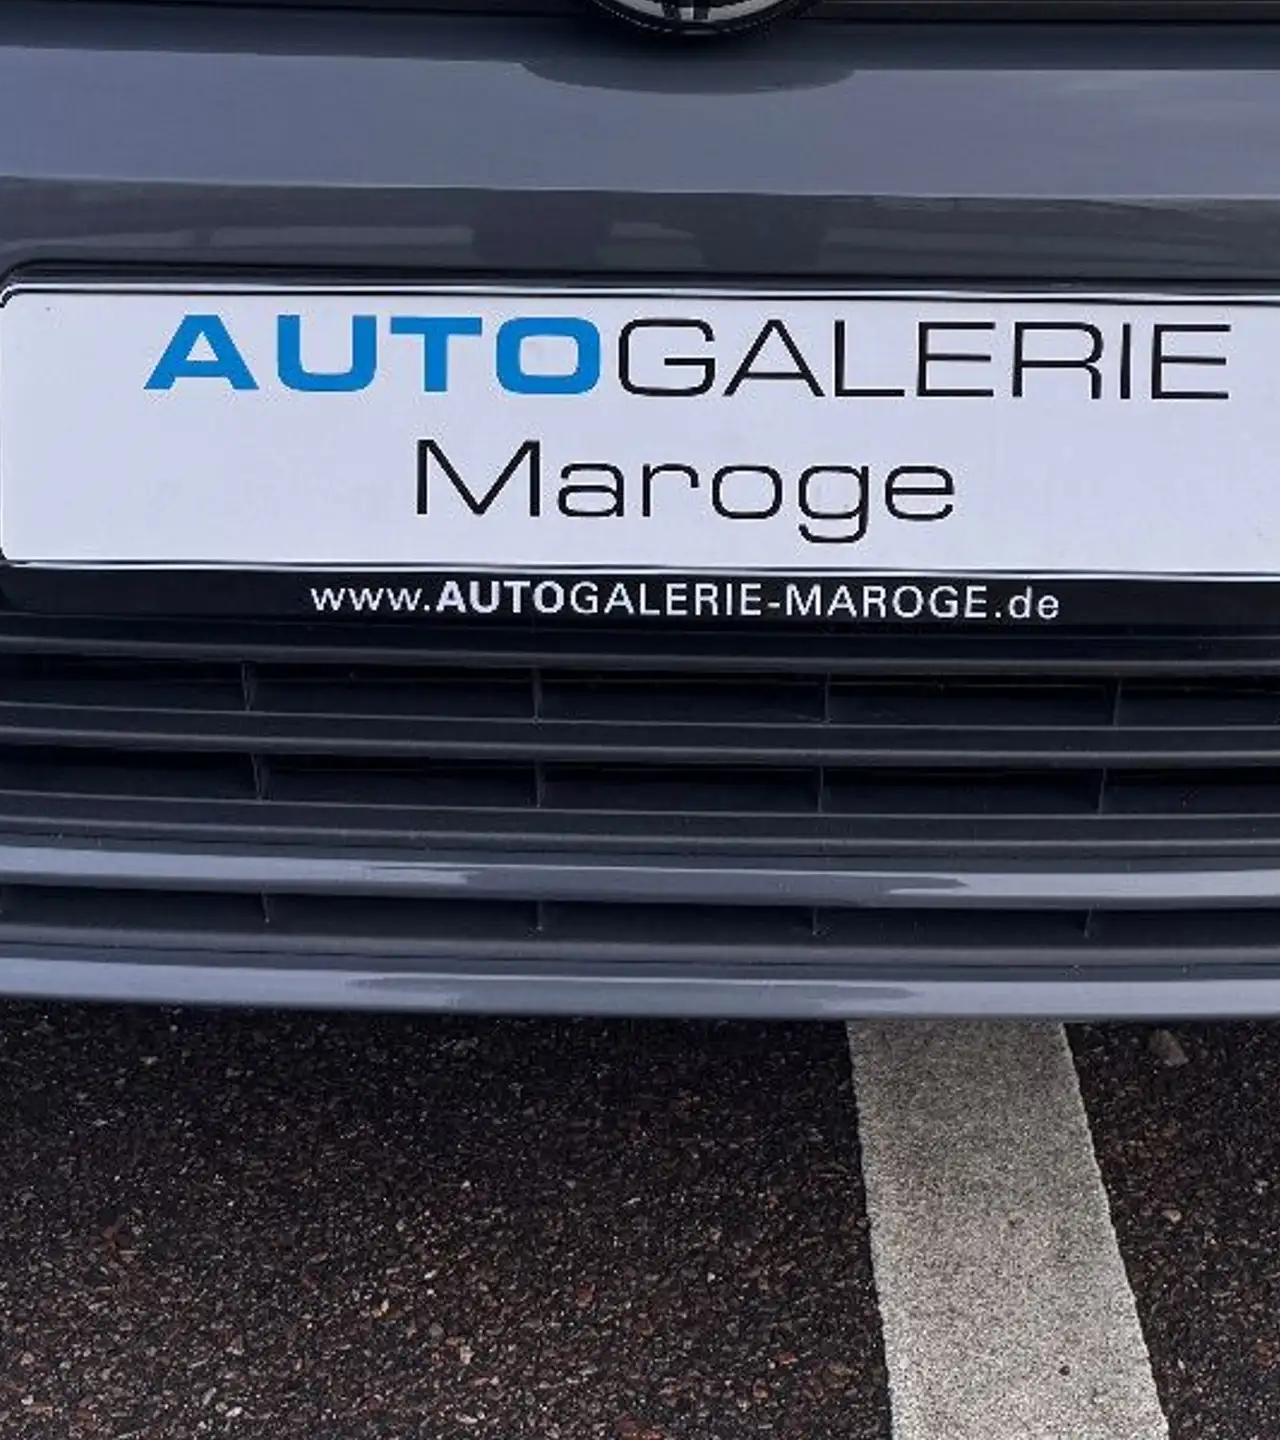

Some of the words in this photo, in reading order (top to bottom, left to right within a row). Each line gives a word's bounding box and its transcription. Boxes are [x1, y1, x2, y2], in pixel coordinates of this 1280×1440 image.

[144, 313, 1231, 401] AUTOGALERIE
[416, 439, 956, 545] Maroge
[310, 580, 1061, 620] www.AUTOGALERIE-MAROGE.de
